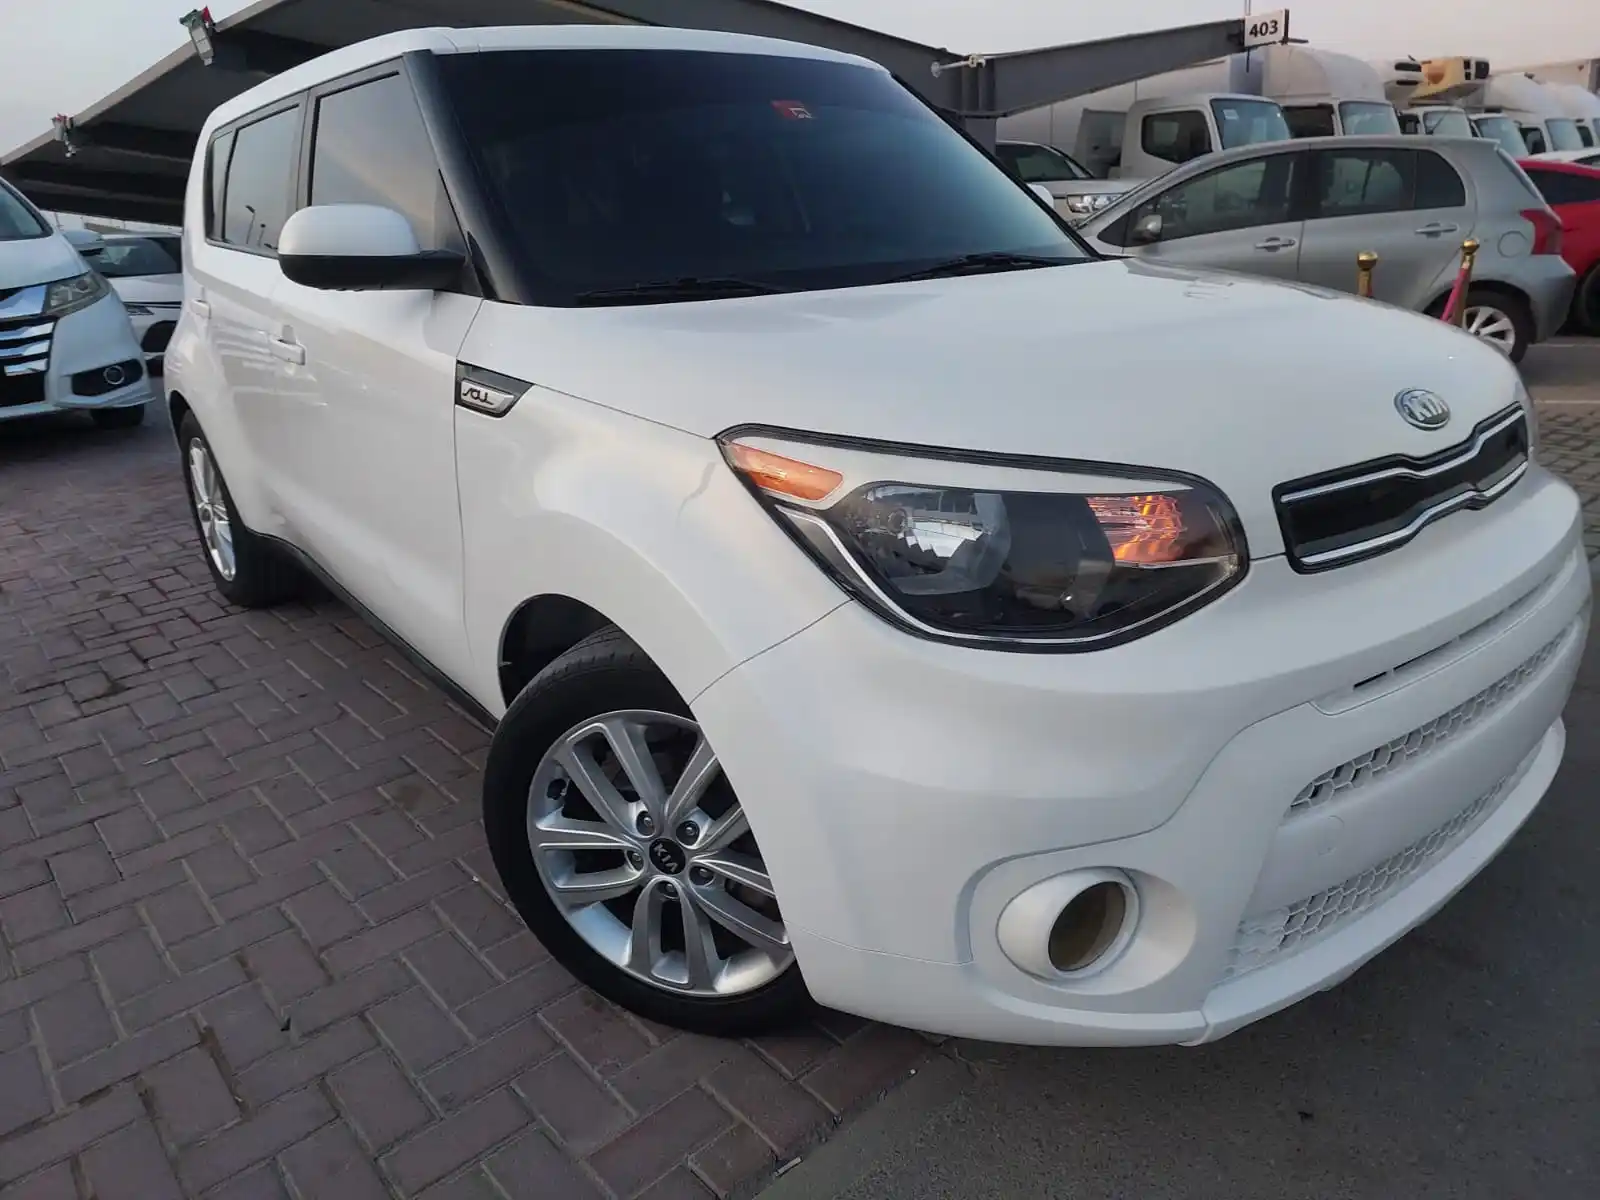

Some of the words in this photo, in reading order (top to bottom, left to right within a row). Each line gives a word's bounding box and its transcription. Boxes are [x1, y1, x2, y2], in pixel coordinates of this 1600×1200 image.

[1249, 20, 1278, 37] 403
[1401, 393, 1449, 422] KIA
[654, 844, 678, 873] KIA
